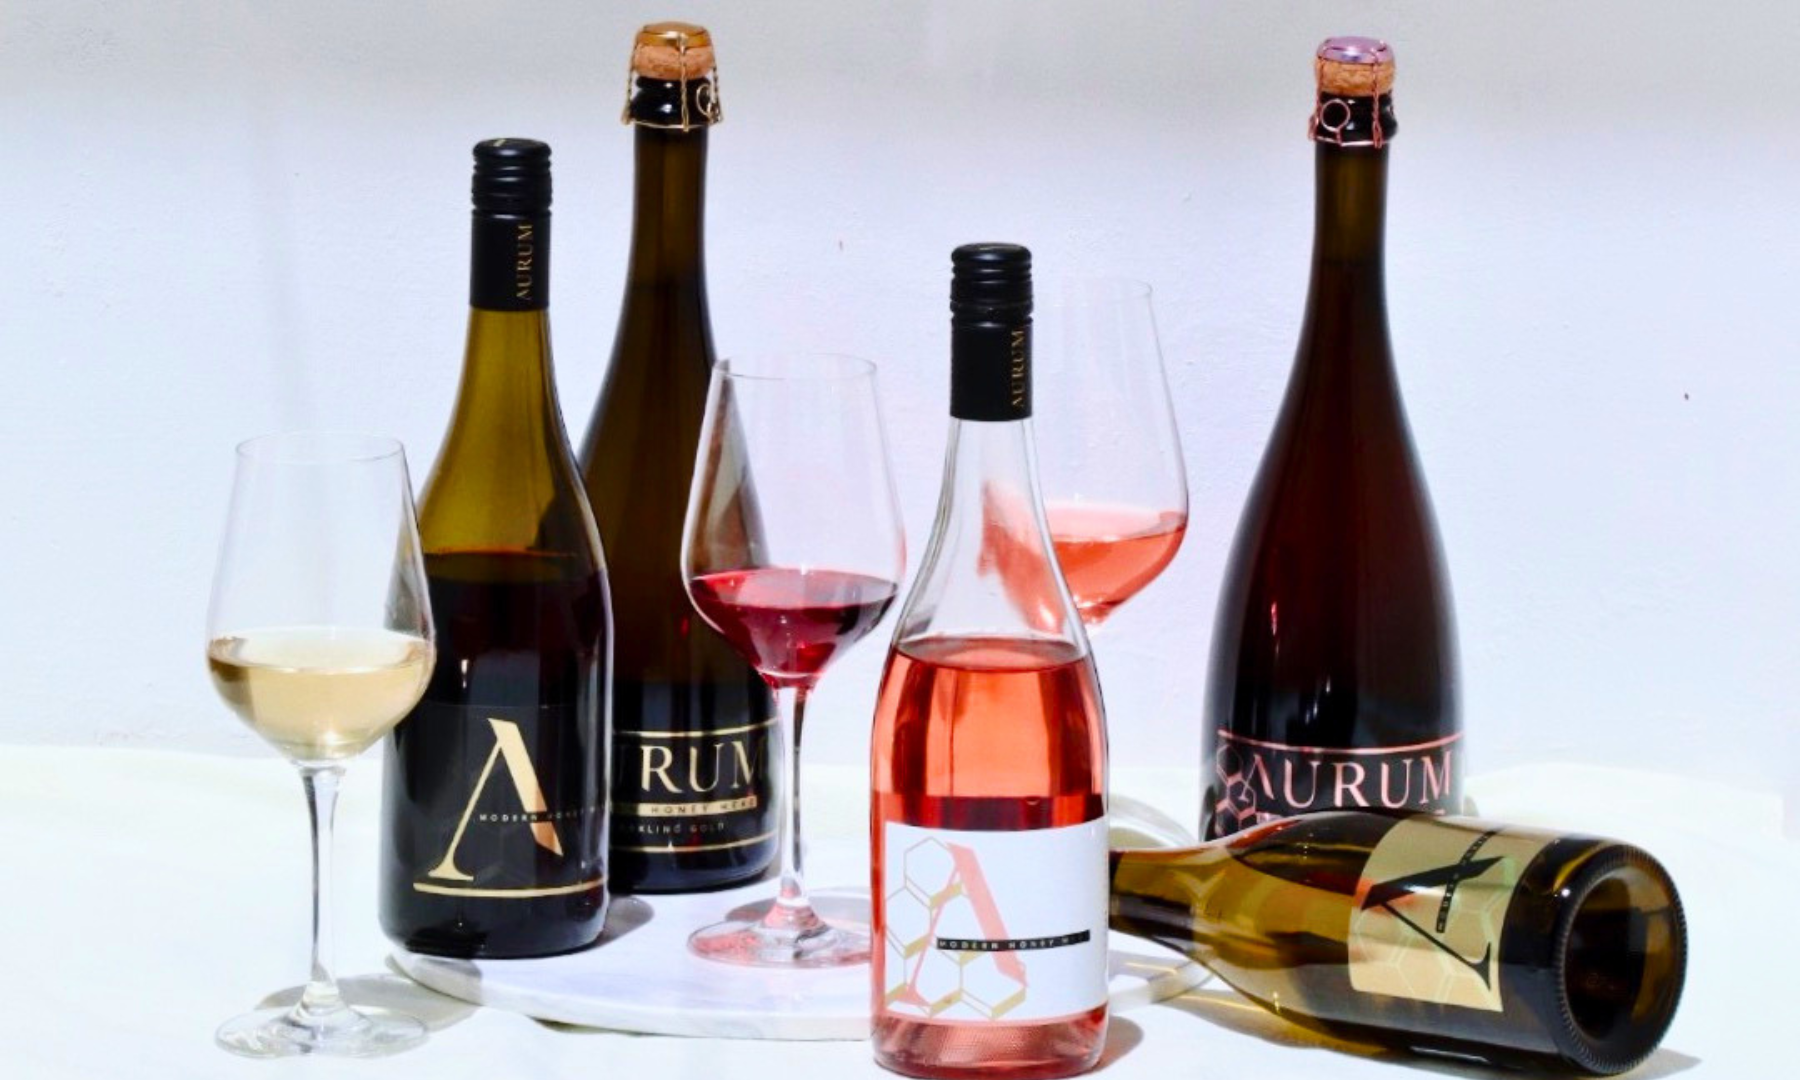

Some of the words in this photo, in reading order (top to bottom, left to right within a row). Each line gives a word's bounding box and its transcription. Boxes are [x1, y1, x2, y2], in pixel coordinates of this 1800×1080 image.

[516, 223, 533, 301] AURUM
[1011, 329, 1025, 408] AURUM
[428, 717, 564, 881] A
[650, 804, 709, 814] HONEY
[1241, 751, 1451, 808] AURUM
[479, 813, 538, 823] MODERN
[629, 823, 683, 835] KLING
[896, 842, 1029, 1006] A
[939, 940, 999, 950] MODERN
[1008, 938, 1054, 949] HONEY
[1361, 856, 1505, 991] A
